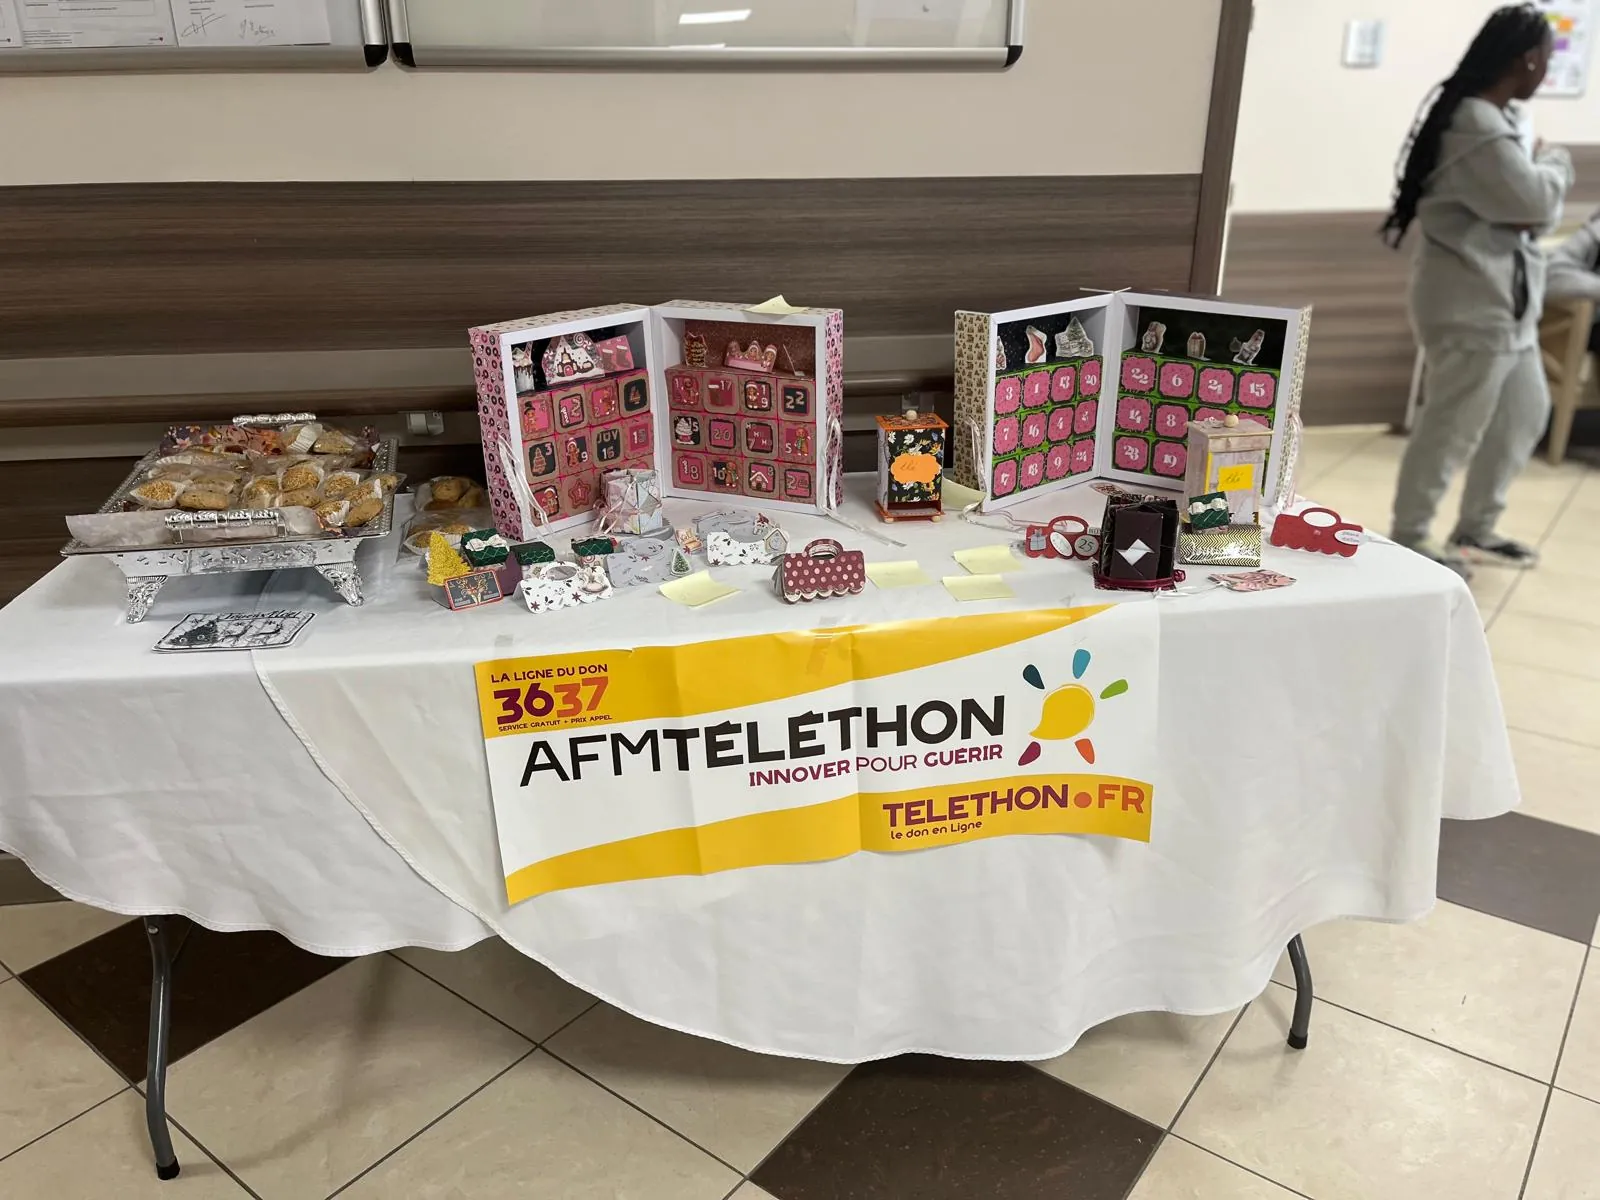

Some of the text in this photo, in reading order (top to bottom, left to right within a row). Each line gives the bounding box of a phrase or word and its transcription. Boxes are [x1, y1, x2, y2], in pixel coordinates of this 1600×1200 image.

[1059, 375, 1070, 389] 13
[1084, 374, 1097, 386] 20
[1130, 367, 1149, 385] 22
[1171, 373, 1183, 387] 6
[719, 380, 732, 391] 17
[1033, 383, 1039, 394] 1
[1207, 379, 1223, 395] 21
[1249, 382, 1266, 397] 15
[785, 391, 805, 409] 22
[1005, 386, 1013, 401] 3
[1056, 417, 1064, 430] 4
[1128, 409, 1142, 424] 14
[1166, 414, 1177, 428] 8
[597, 430, 619, 443] JOY
[712, 428, 731, 441] 20
[1003, 427, 1010, 440] 7
[1028, 423, 1040, 438] 16
[601, 446, 615, 460] 16
[784, 442, 793, 454] 5
[1123, 444, 1140, 461] 23
[580, 451, 589, 462] 9
[1054, 456, 1062, 470] 9
[1163, 453, 1177, 468] 19
[682, 460, 699, 480] 18
[712, 467, 726, 481] 10
[1028, 463, 1038, 476] 18
[1001, 472, 1010, 486] 17
[1078, 538, 1095, 553] 25
[491, 663, 608, 684] LA LIGNE DU DON
[493, 676, 609, 725] 3637
[498, 723, 528, 732] SERVICE
[530, 719, 560, 728] GRATUIT
[519, 695, 1006, 788] AFMTÉLÉTHON
[749, 743, 1003, 787] INNOVER POUR GUÉRIR
[890, 820, 983, 840] le don en Ligne
